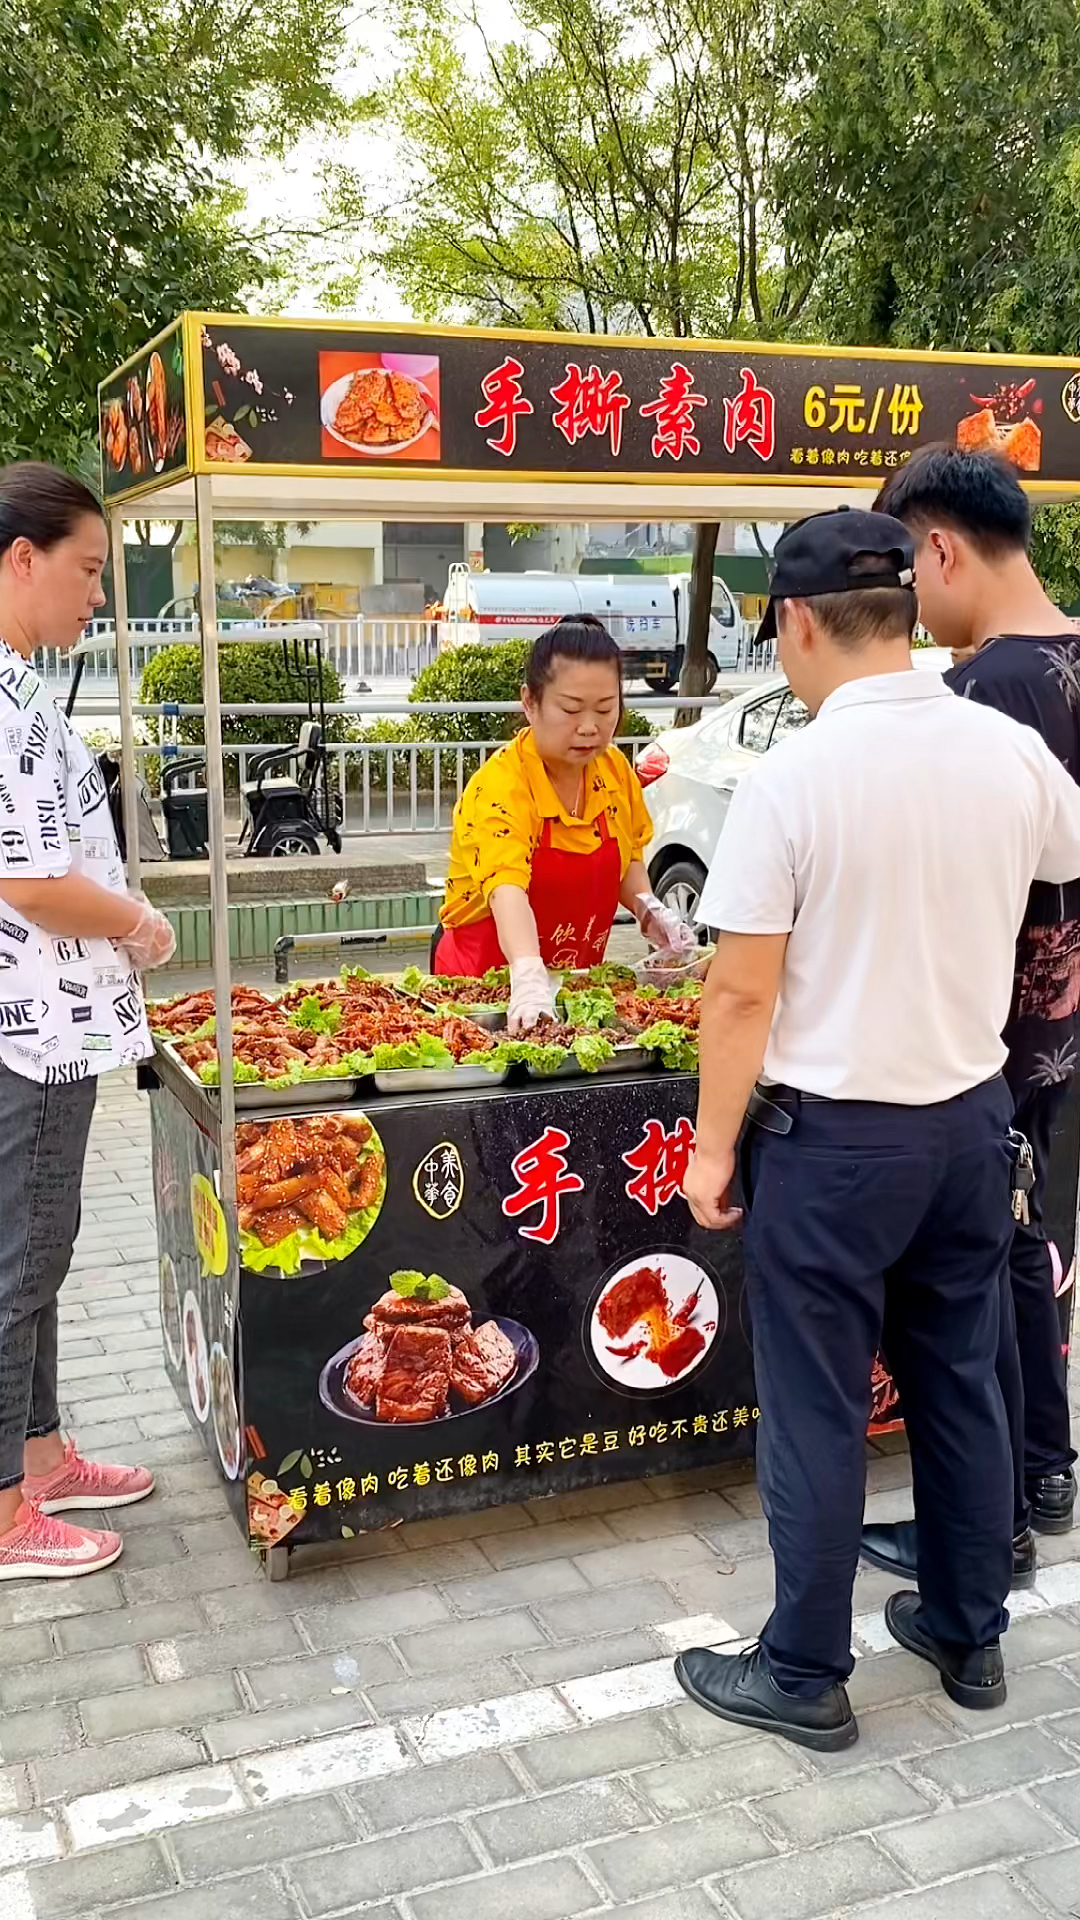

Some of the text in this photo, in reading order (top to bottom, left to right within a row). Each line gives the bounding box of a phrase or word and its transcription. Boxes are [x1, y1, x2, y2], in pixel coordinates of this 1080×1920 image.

[474, 356, 775, 461] 手撕素肉
[804, 383, 924, 435] 6元/份
[790, 447, 850, 465] 看着像肉
[288, 1472, 379, 1510] 看着像肉
[388, 1450, 499, 1490] 吃着还像肉
[513, 1430, 620, 1467] 其实它是豆
